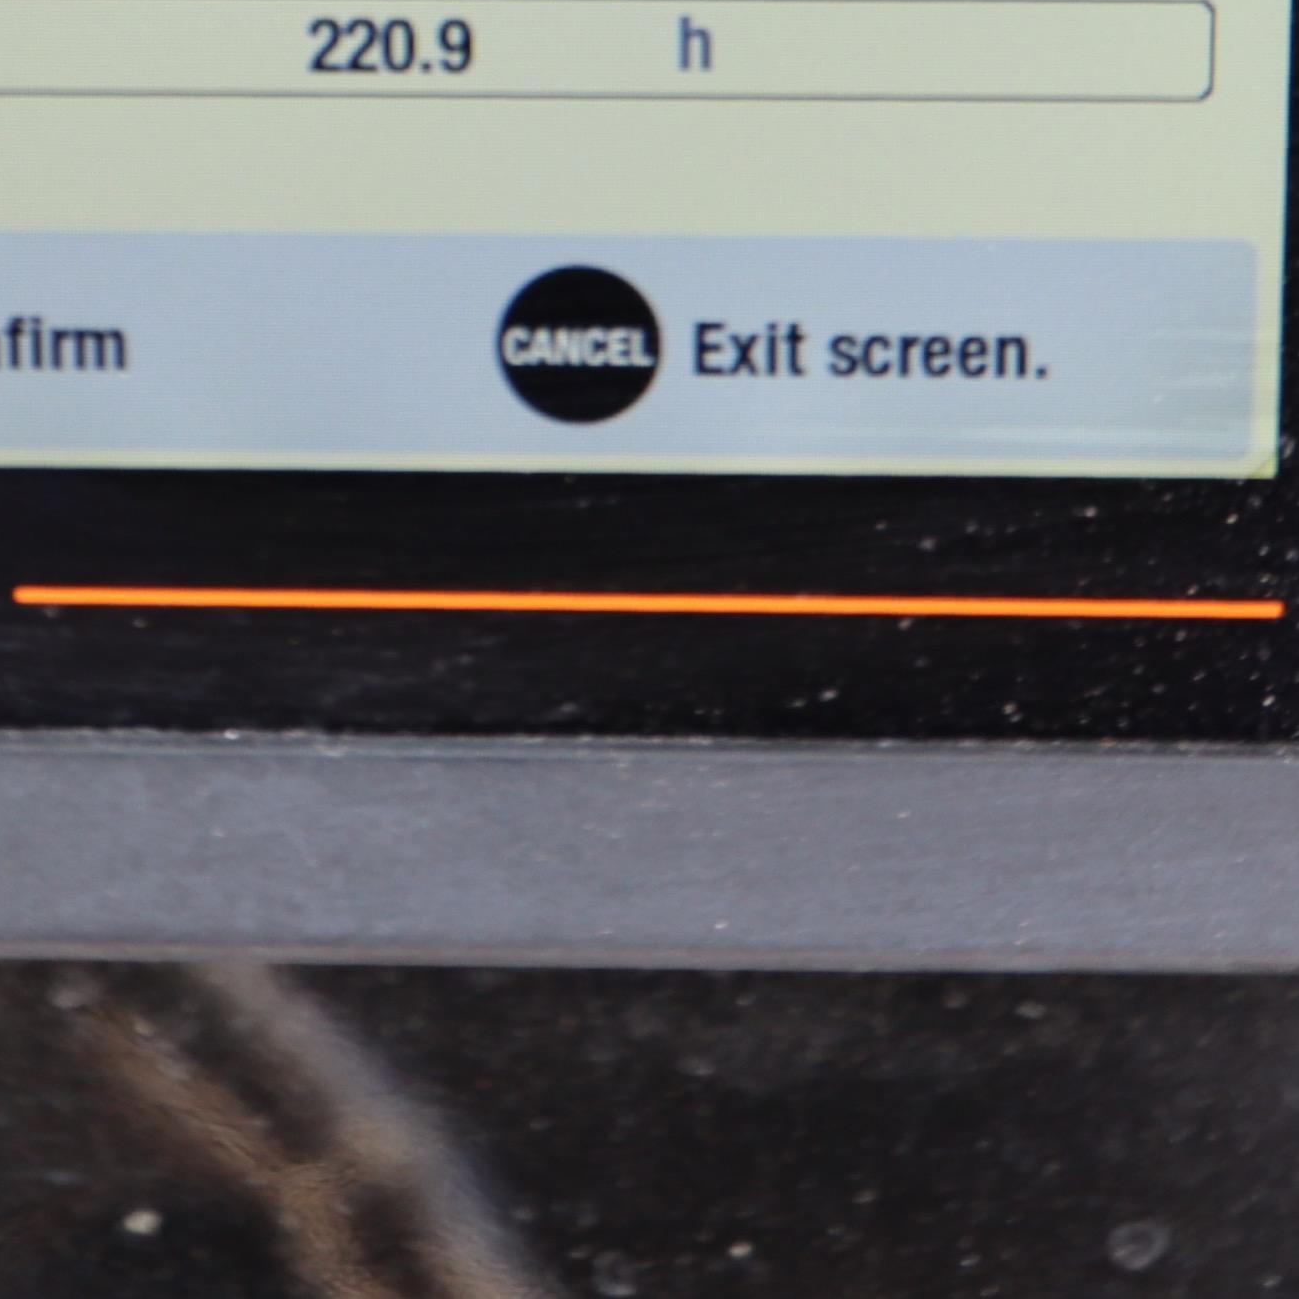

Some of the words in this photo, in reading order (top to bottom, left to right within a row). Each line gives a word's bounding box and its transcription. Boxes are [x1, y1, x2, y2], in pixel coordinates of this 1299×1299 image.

[308, 17, 474, 74] 220.9
[678, 17, 713, 72] h
[503, 326, 656, 369] CANCEL
[692, 321, 806, 377] Exit
[828, 333, 1049, 379] screen.
